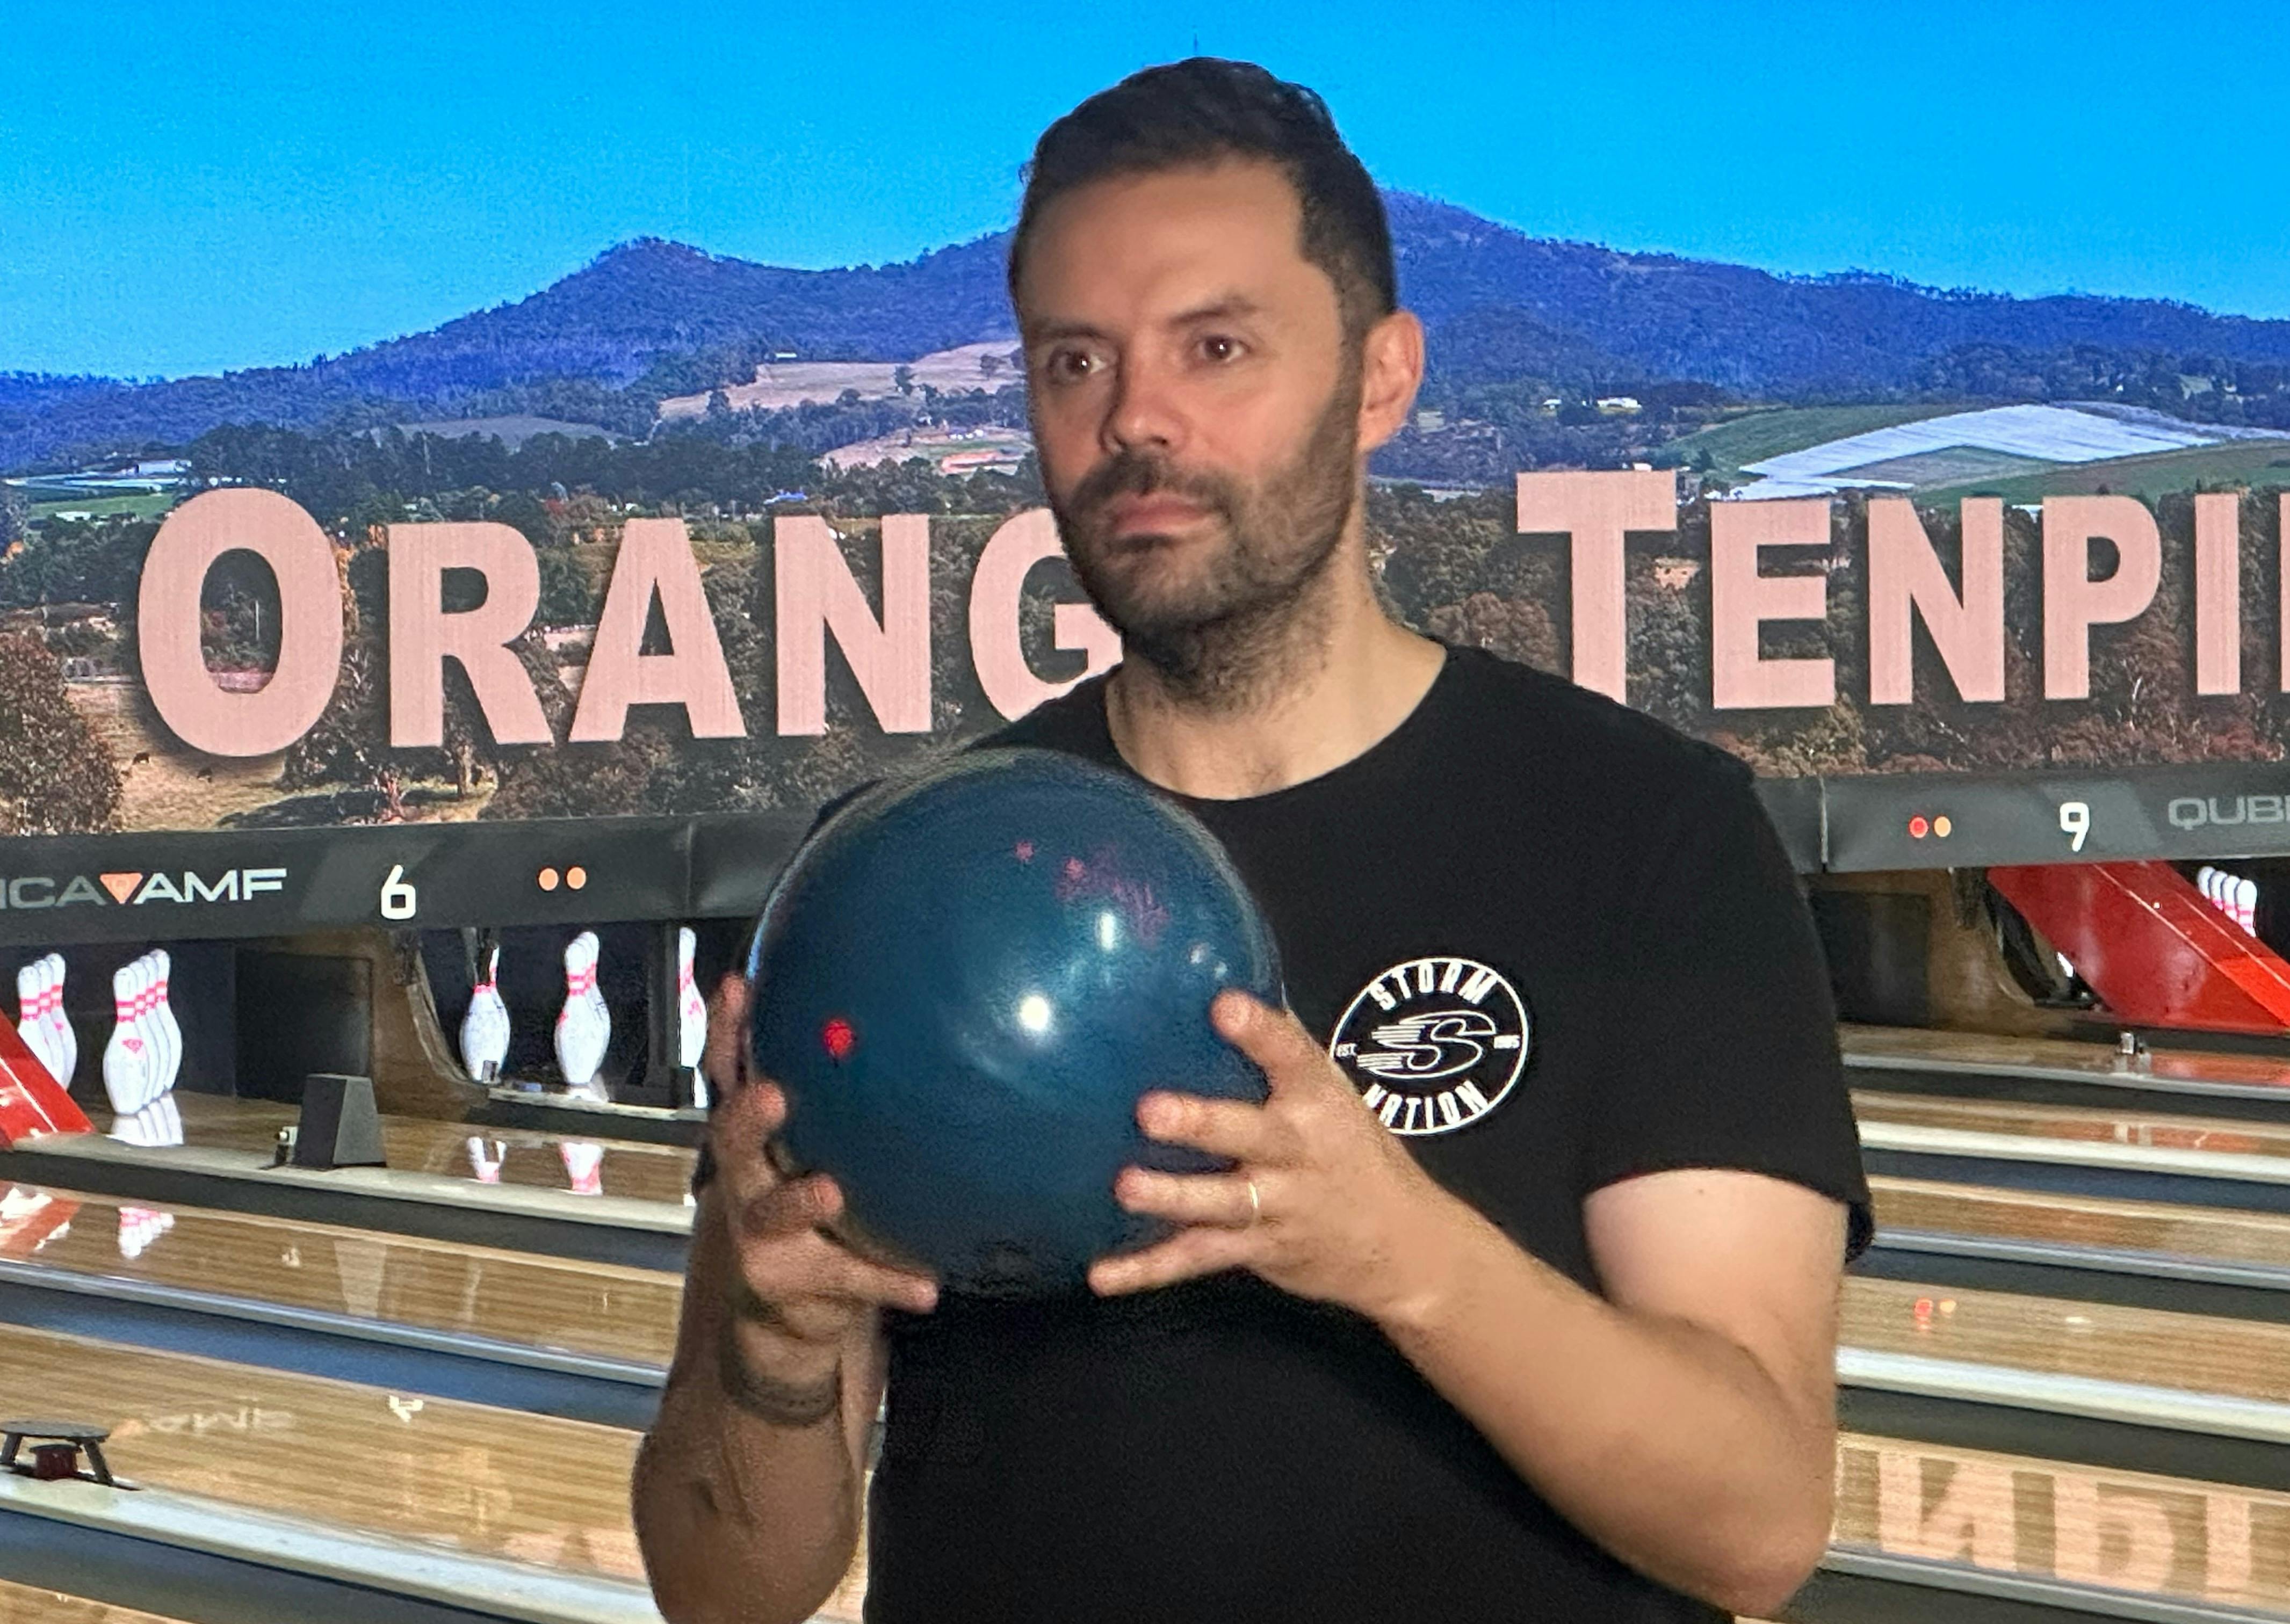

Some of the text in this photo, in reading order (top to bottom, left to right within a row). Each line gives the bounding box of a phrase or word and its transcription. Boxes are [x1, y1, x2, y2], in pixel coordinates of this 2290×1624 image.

[139, 468, 2290, 756] ORANG TENPI
[2060, 802, 2090, 852] 9
[133, 868, 287, 905] AMF
[381, 865, 416, 919] 6
[1369, 962, 1499, 1010] STORM
[1363, 1080, 1489, 1130] NATION
